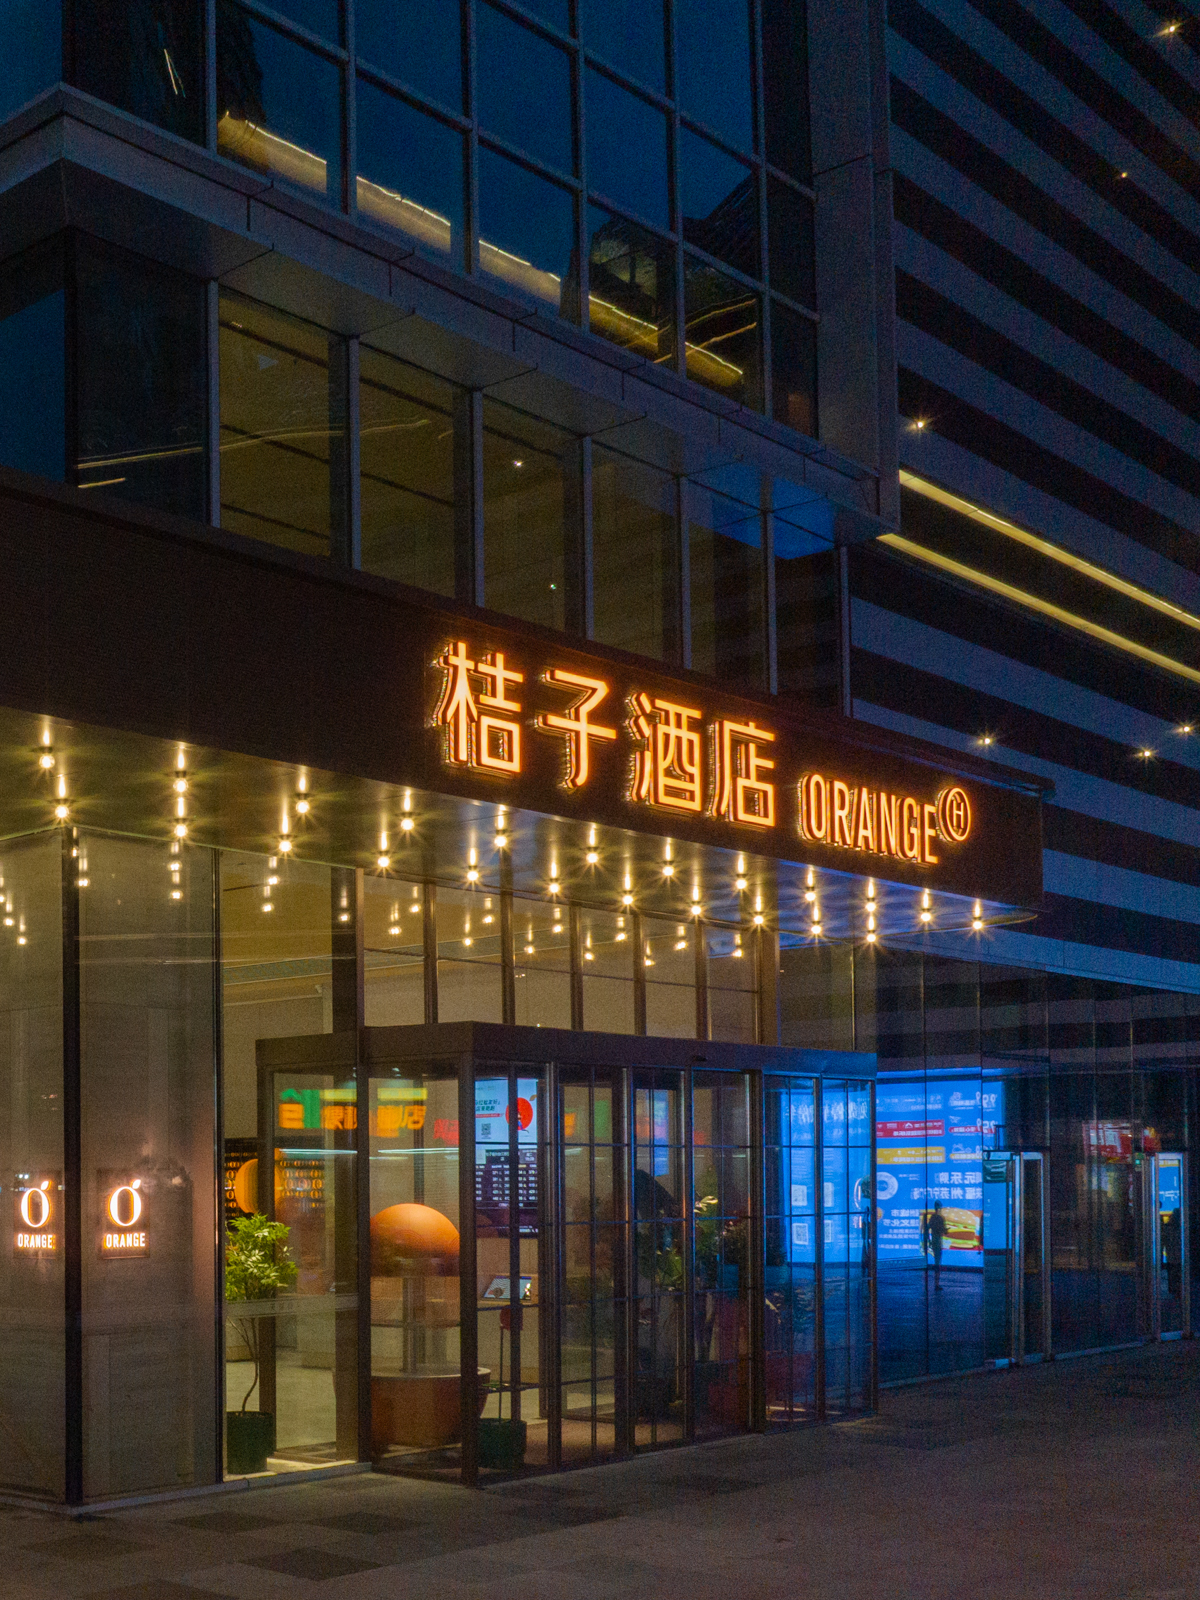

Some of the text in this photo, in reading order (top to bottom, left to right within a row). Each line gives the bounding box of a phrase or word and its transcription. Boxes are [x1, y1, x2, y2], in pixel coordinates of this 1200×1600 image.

[433, 640, 776, 828] 桔子酒店
[800, 774, 940, 865] ORANGE
[17, 1233, 53, 1249] ORANGE
[105, 1232, 146, 1248] ORANGE
